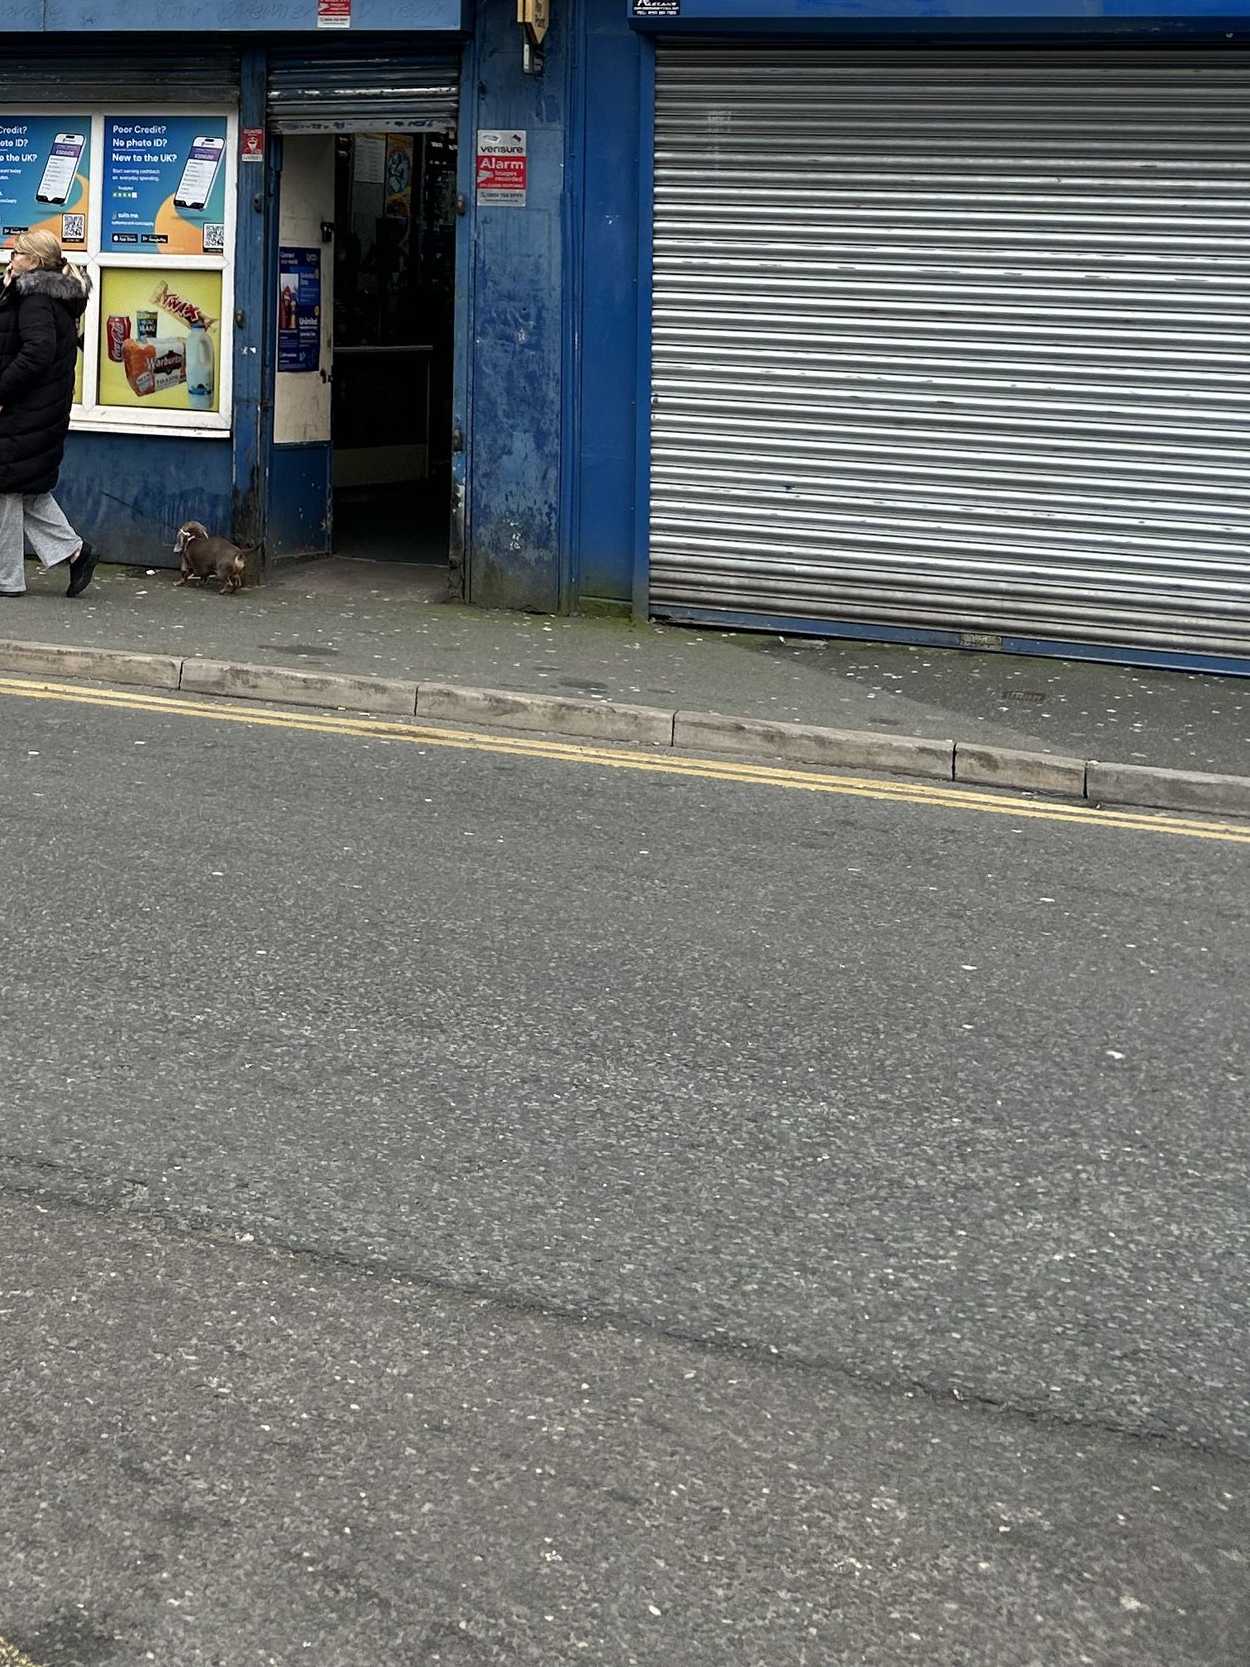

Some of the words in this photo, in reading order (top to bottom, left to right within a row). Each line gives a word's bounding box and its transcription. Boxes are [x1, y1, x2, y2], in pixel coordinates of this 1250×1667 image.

[112, 125, 132, 134] Poor
[134, 125, 166, 134] Credit?
[15, 138, 28, 147] ID?
[112, 138, 124, 147] No
[126, 138, 151, 148] photo
[153, 138, 167, 147] ID?
[480, 145, 523, 154] verisure
[6, 153, 20, 162] the
[22, 153, 37, 162] UK?
[112, 153, 131, 162] New
[133, 153, 142, 162] to
[144, 153, 158, 162] the
[160, 153, 177, 162] UK?
[480, 157, 523, 170] Alarm
